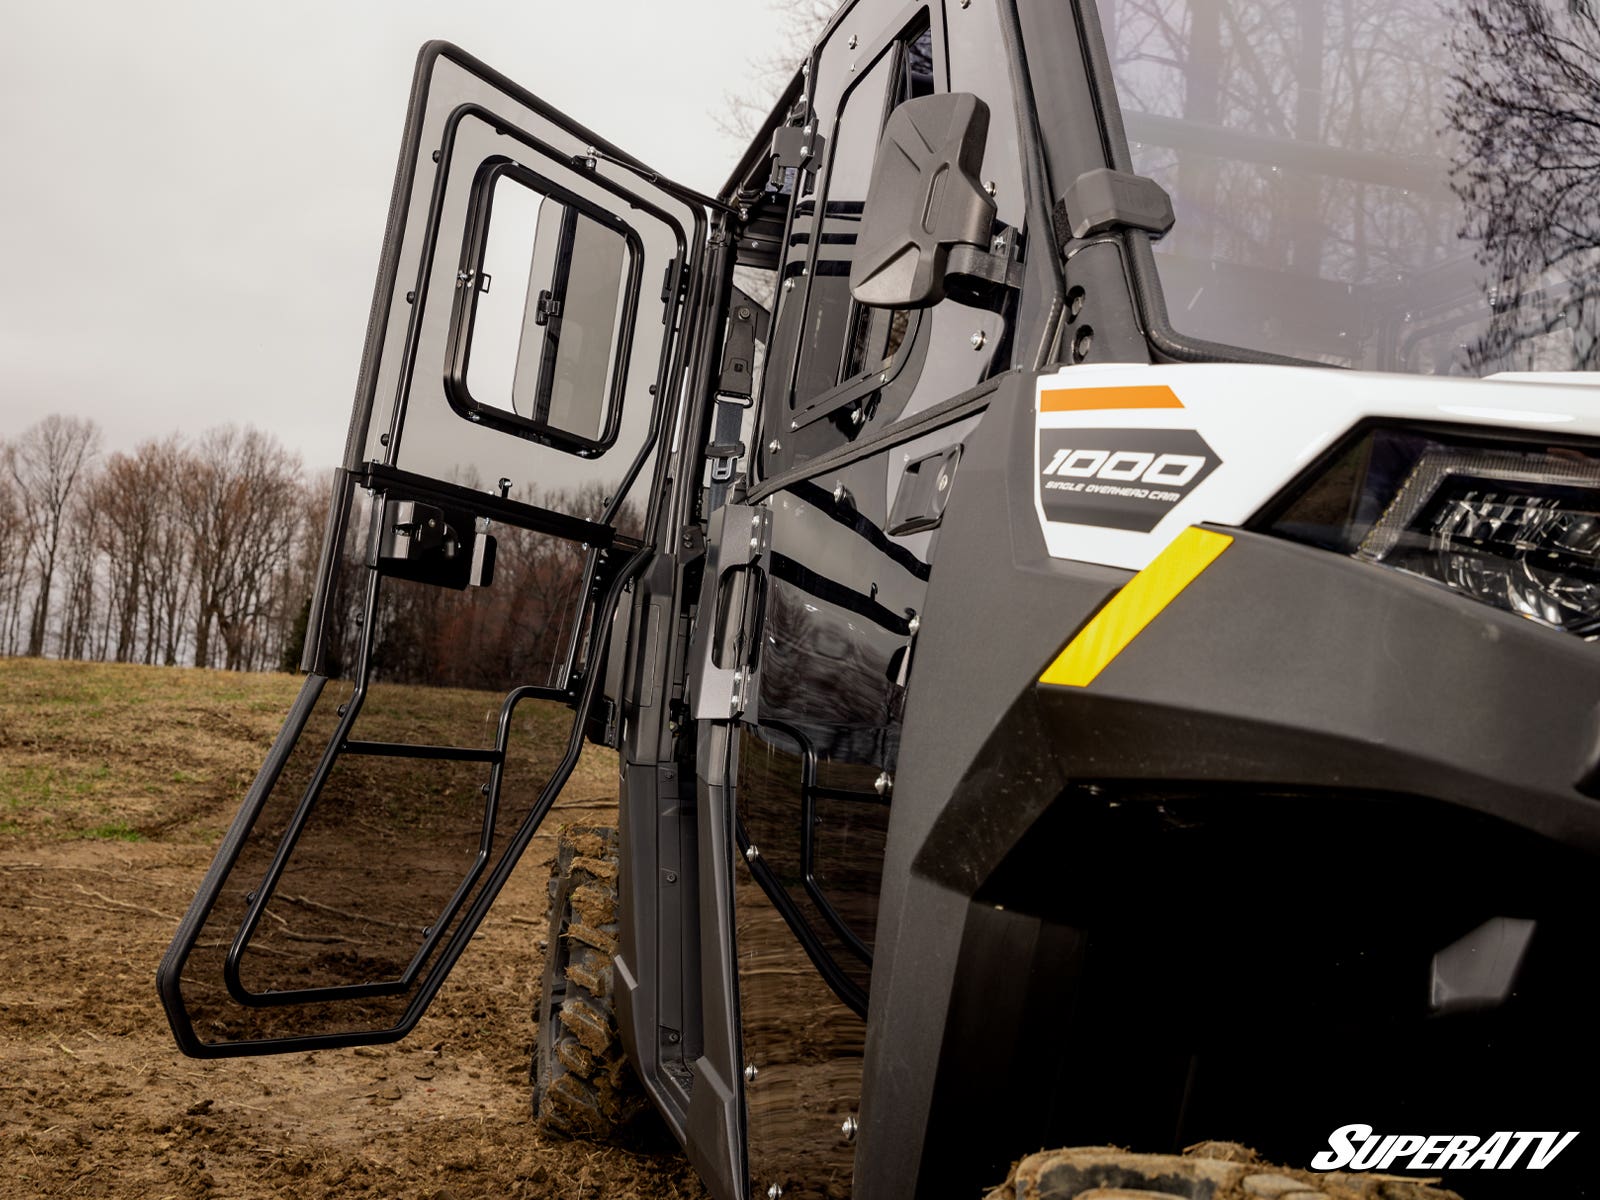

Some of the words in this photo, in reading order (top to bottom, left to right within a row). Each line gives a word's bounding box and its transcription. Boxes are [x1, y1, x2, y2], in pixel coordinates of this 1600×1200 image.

[1042, 448, 1207, 487] 1000
[1044, 480, 1086, 492] SINGLE
[1085, 484, 1150, 499] OVERHEAD
[1147, 490, 1181, 503] CAM
